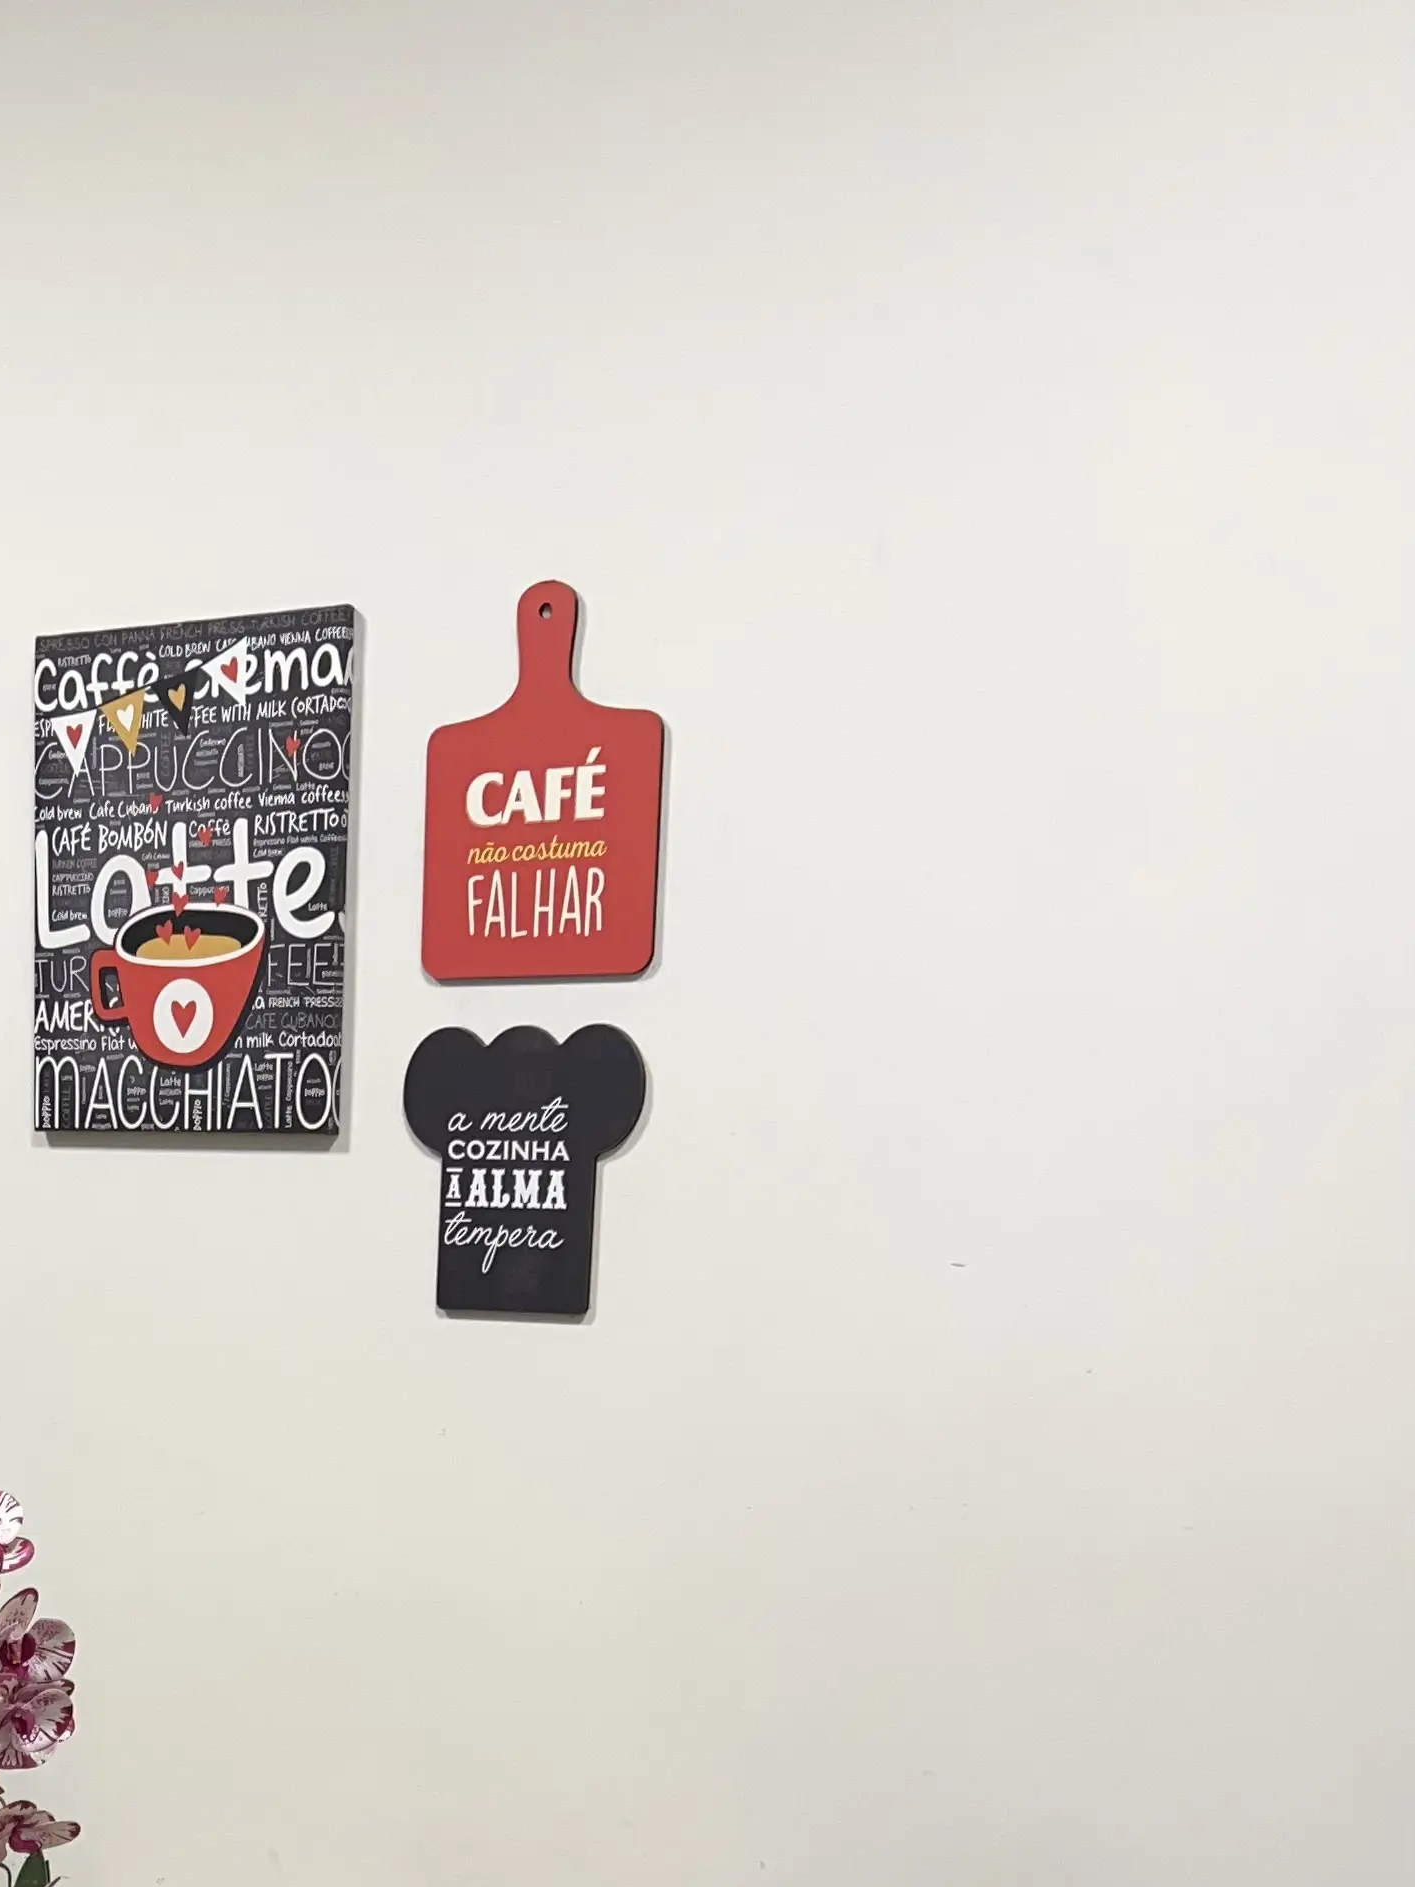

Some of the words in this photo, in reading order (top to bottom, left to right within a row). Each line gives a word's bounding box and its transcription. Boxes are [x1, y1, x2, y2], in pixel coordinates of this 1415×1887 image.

[159, 644, 184, 658] COLD
[185, 640, 211, 658] BREW
[215, 637, 237, 653] CAF
[246, 633, 277, 651] UBANO
[279, 630, 312, 646] VIENNA
[141, 709, 170, 730] HITE
[221, 702, 252, 724] WITH
[256, 700, 287, 721] MILK
[34, 726, 342, 800] CAPPUCCINO
[465, 746, 607, 828] CAFÉ
[57, 806, 83, 822] brew
[89, 800, 117, 820] Cafe
[166, 794, 211, 814] Turkish
[214, 791, 253, 811] coffee
[258, 788, 295, 807] Vienna
[52, 821, 92, 857] CAFÉ
[466, 842, 510, 865] não
[511, 834, 609, 862] costuma
[35, 817, 337, 950] Latte
[467, 864, 606, 939] FALHAR
[269, 996, 300, 1008] FRENCH
[245, 1012, 278, 1031] CAFE
[280, 1011, 335, 1033] CUBANO
[34, 1035, 97, 1056] Espressino
[101, 1035, 126, 1052] Flat
[246, 1032, 274, 1049] milk
[34, 1053, 332, 1131] MACCHIATO
[447, 1112, 473, 1132] a
[480, 1095, 569, 1133] mente
[447, 1139, 570, 1161] COZINHA
[463, 1168, 567, 1210] ALMA
[443, 1210, 565, 1274] tempera
